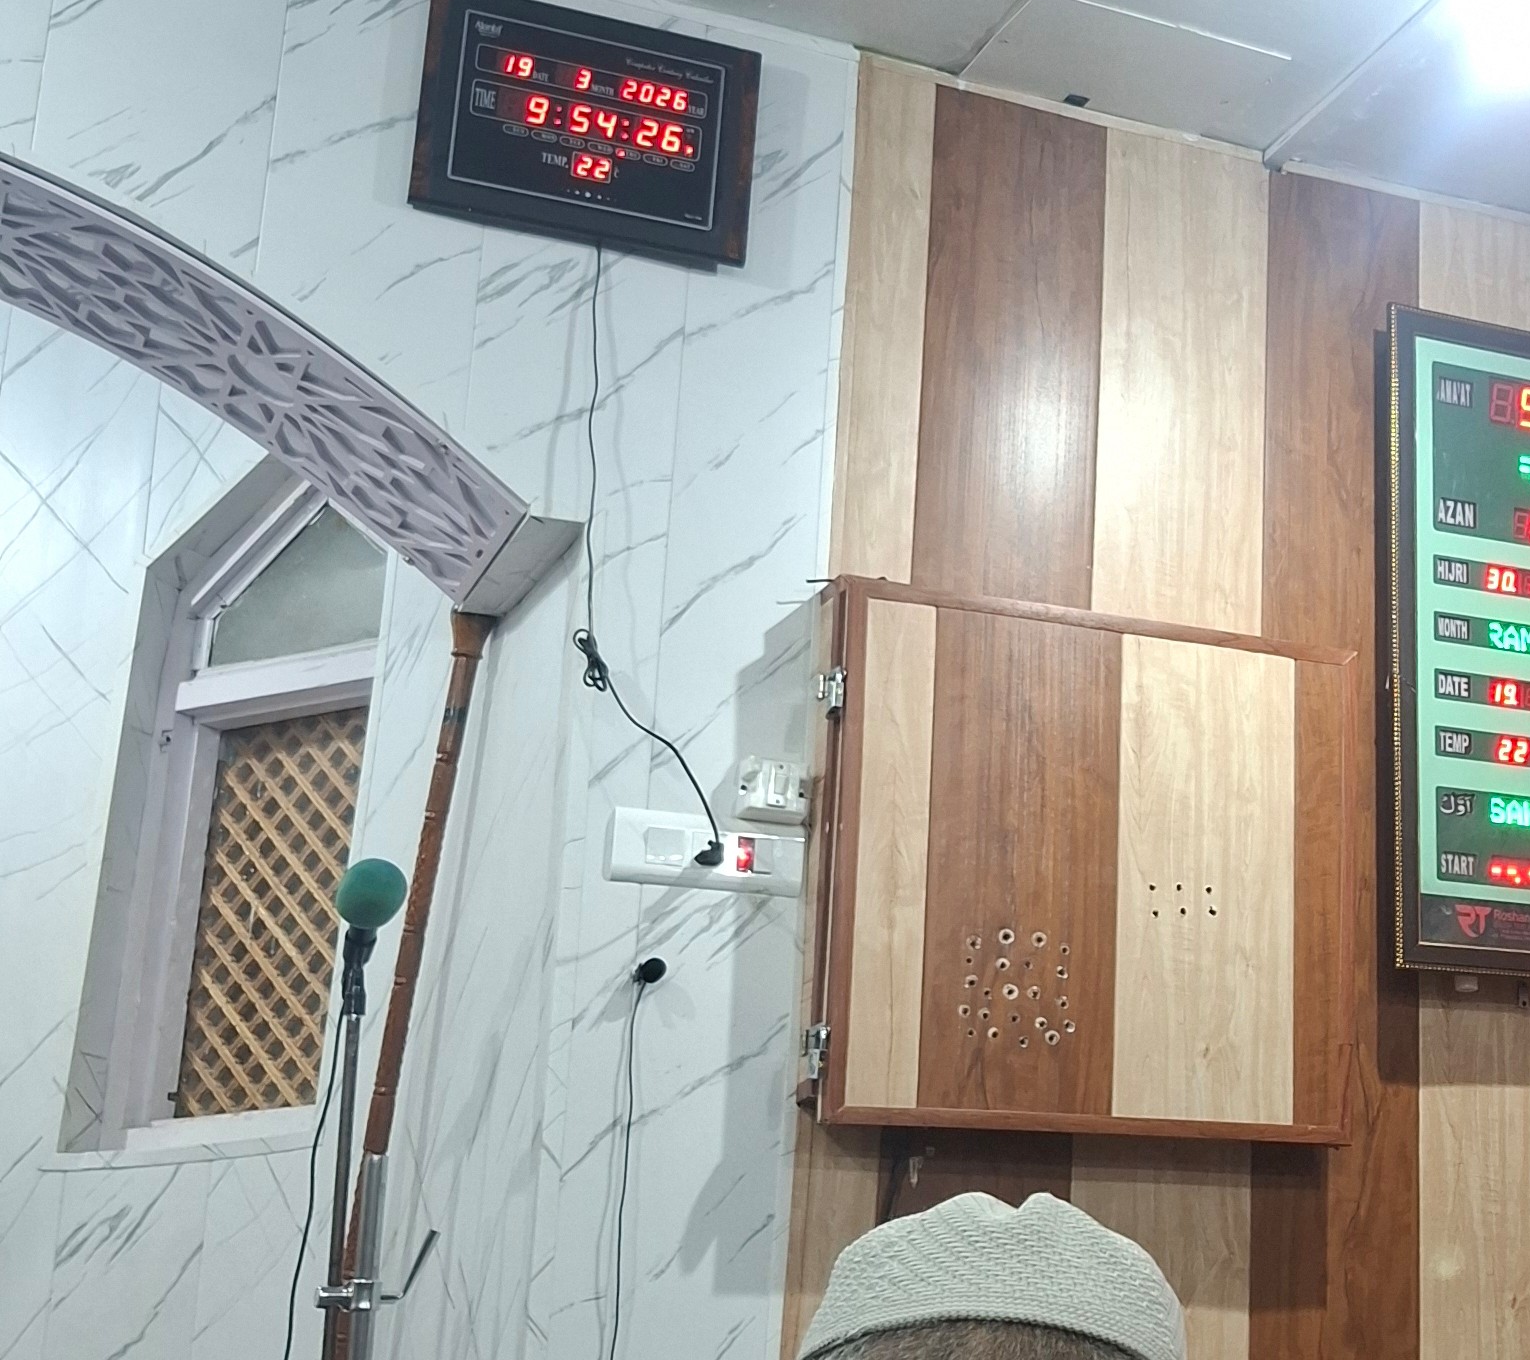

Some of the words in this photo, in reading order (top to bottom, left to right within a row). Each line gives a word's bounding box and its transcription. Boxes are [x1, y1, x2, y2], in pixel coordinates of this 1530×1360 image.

[505, 55, 534, 78] 19
[532, 71, 549, 82] DATE
[575, 69, 592, 90] 3
[591, 83, 614, 96] MONTH
[622, 80, 687, 111] 2026
[475, 88, 496, 110] TIME
[541, 152, 569, 168] TEMP.
[575, 157, 610, 179] 22
[1438, 498, 1474, 527] AZAN
[1437, 560, 1467, 583] HIJRI
[1437, 617, 1468, 639] MONTH
[1438, 674, 1469, 697] DATE
[1439, 731, 1470, 754] TEMP
[1499, 739, 1528, 763] 22
[1440, 854, 1474, 875] START
[1493, 909, 1530, 923] Roshan
